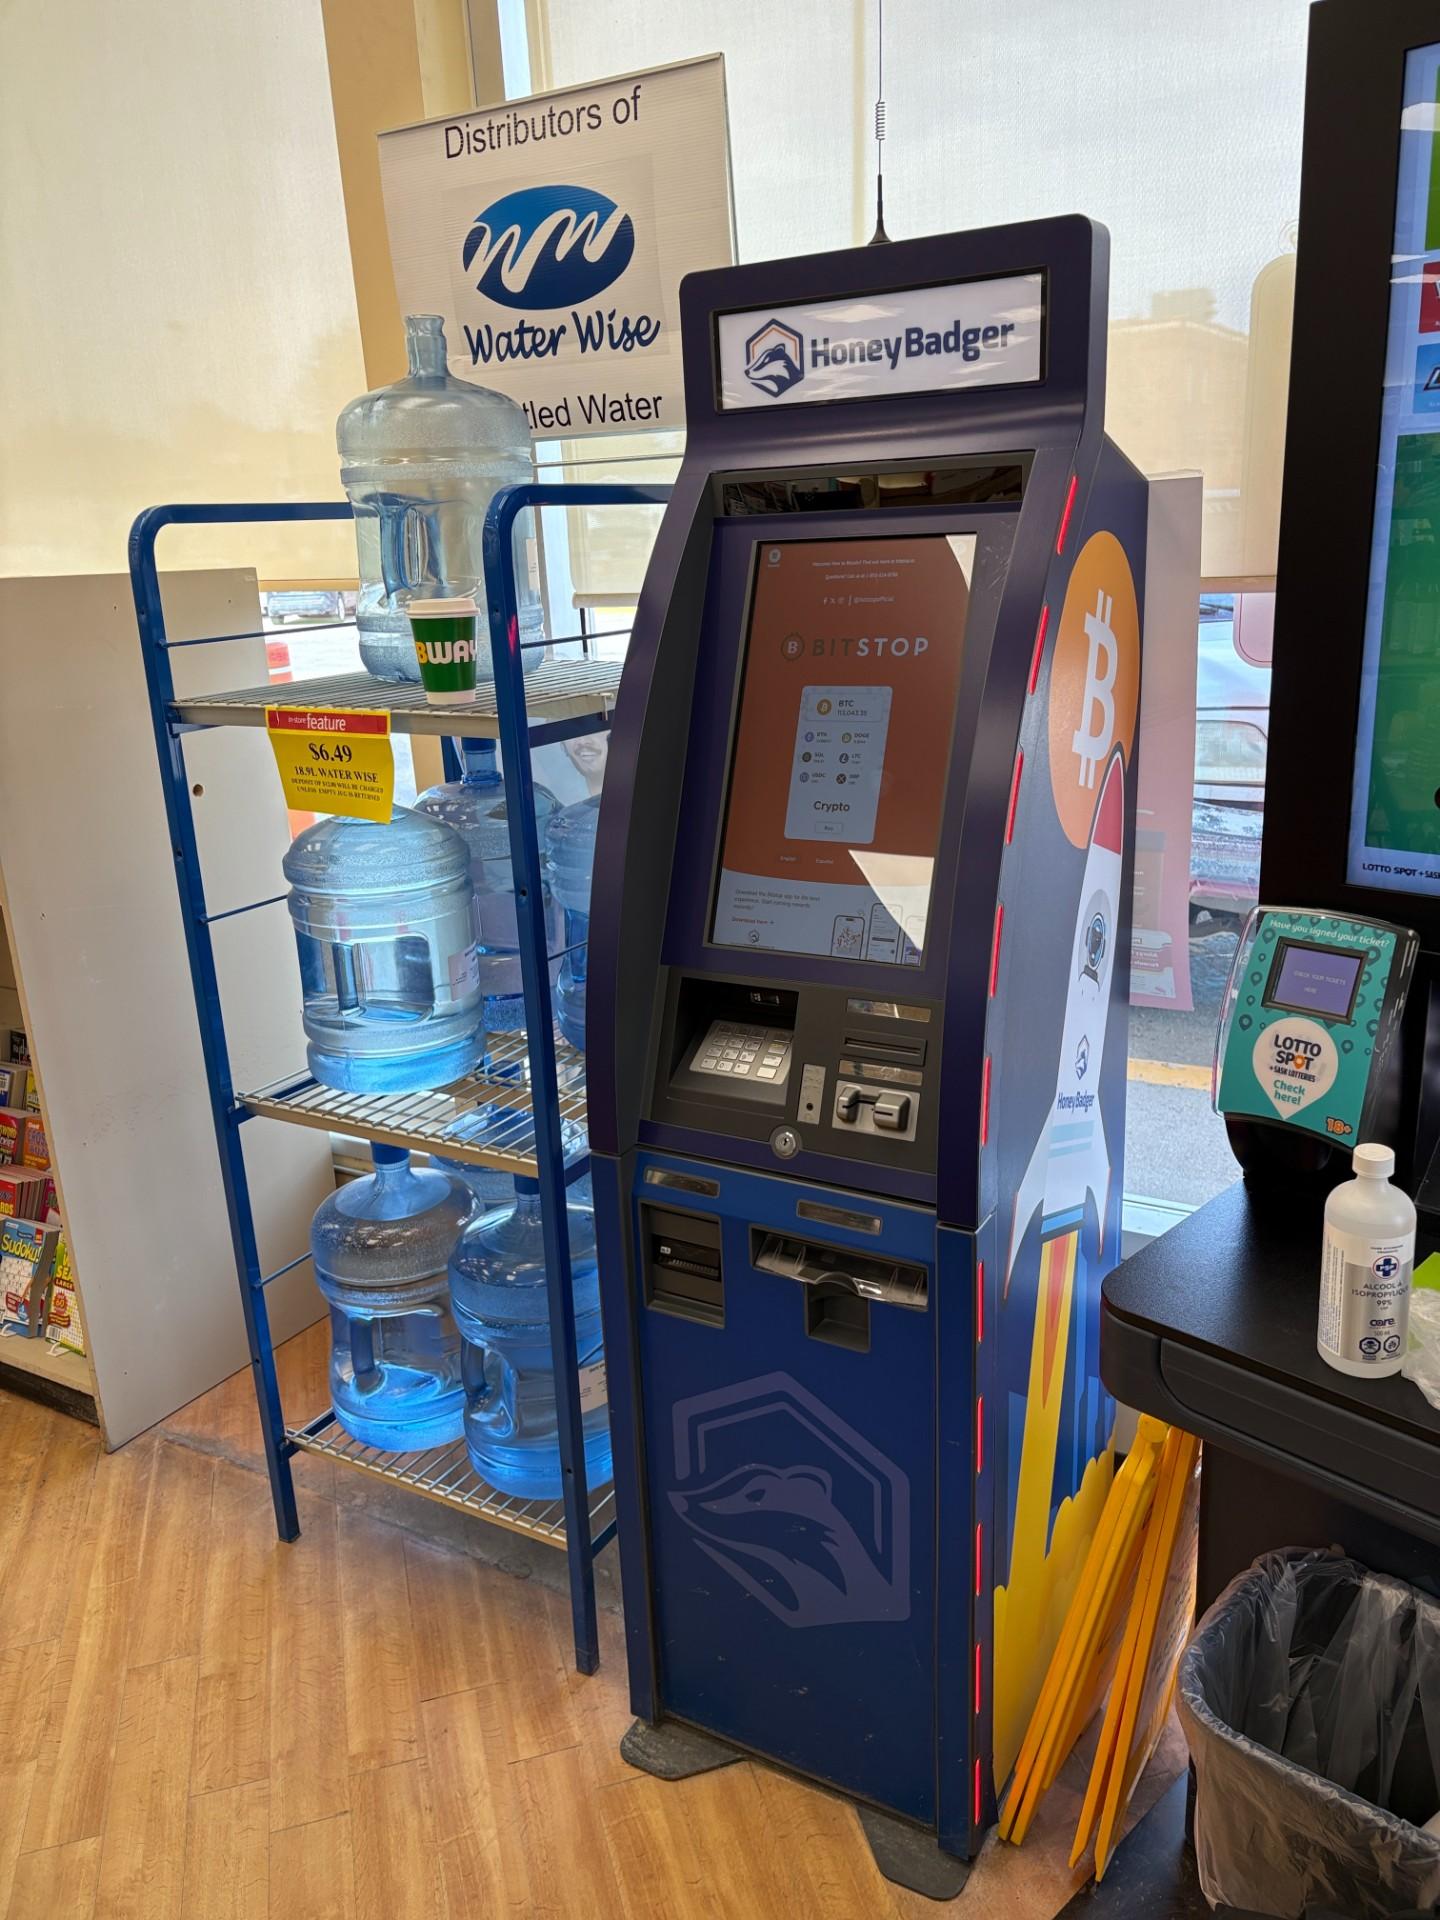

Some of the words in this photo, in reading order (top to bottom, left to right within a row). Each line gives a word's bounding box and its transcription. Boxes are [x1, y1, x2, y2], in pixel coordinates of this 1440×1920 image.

[445, 103, 602, 159] Distributors
[612, 85, 642, 124] of
[463, 319, 567, 365] Water
[571, 308, 661, 353] Wise
[811, 319, 1015, 370] HoneyBadger
[577, 394, 662, 425] Water
[307, 713, 346, 731] feature
[308, 743, 353, 762] $6.49
[318, 767, 353, 780] WATER
[353, 771, 379, 783] WISE
[813, 800, 850, 812] Crypto
[1362, 863, 1391, 873] LOTTO
[1393, 866, 1418, 876] SPOT
[1270, 919, 1291, 929] Have
[1291, 923, 1308, 933] you
[1309, 925, 1337, 938] signed
[1337, 931, 1358, 942] your
[1359, 933, 1390, 947] ticket?
[1274, 1034, 1322, 1057] LOTTO
[1275, 1050, 1314, 1071] SPOT
[1274, 1065, 1288, 1076] SASK
[1288, 1069, 1316, 1082] LOTTERIES
[1273, 1079, 1305, 1096] Check
[1057, 1089, 1095, 1113] HoneyBadger
[1273, 1090, 1302, 1106] here!
[1, 1234, 42, 1263] Sudoku!
[1363, 1282, 1396, 1290] ALCOOL
